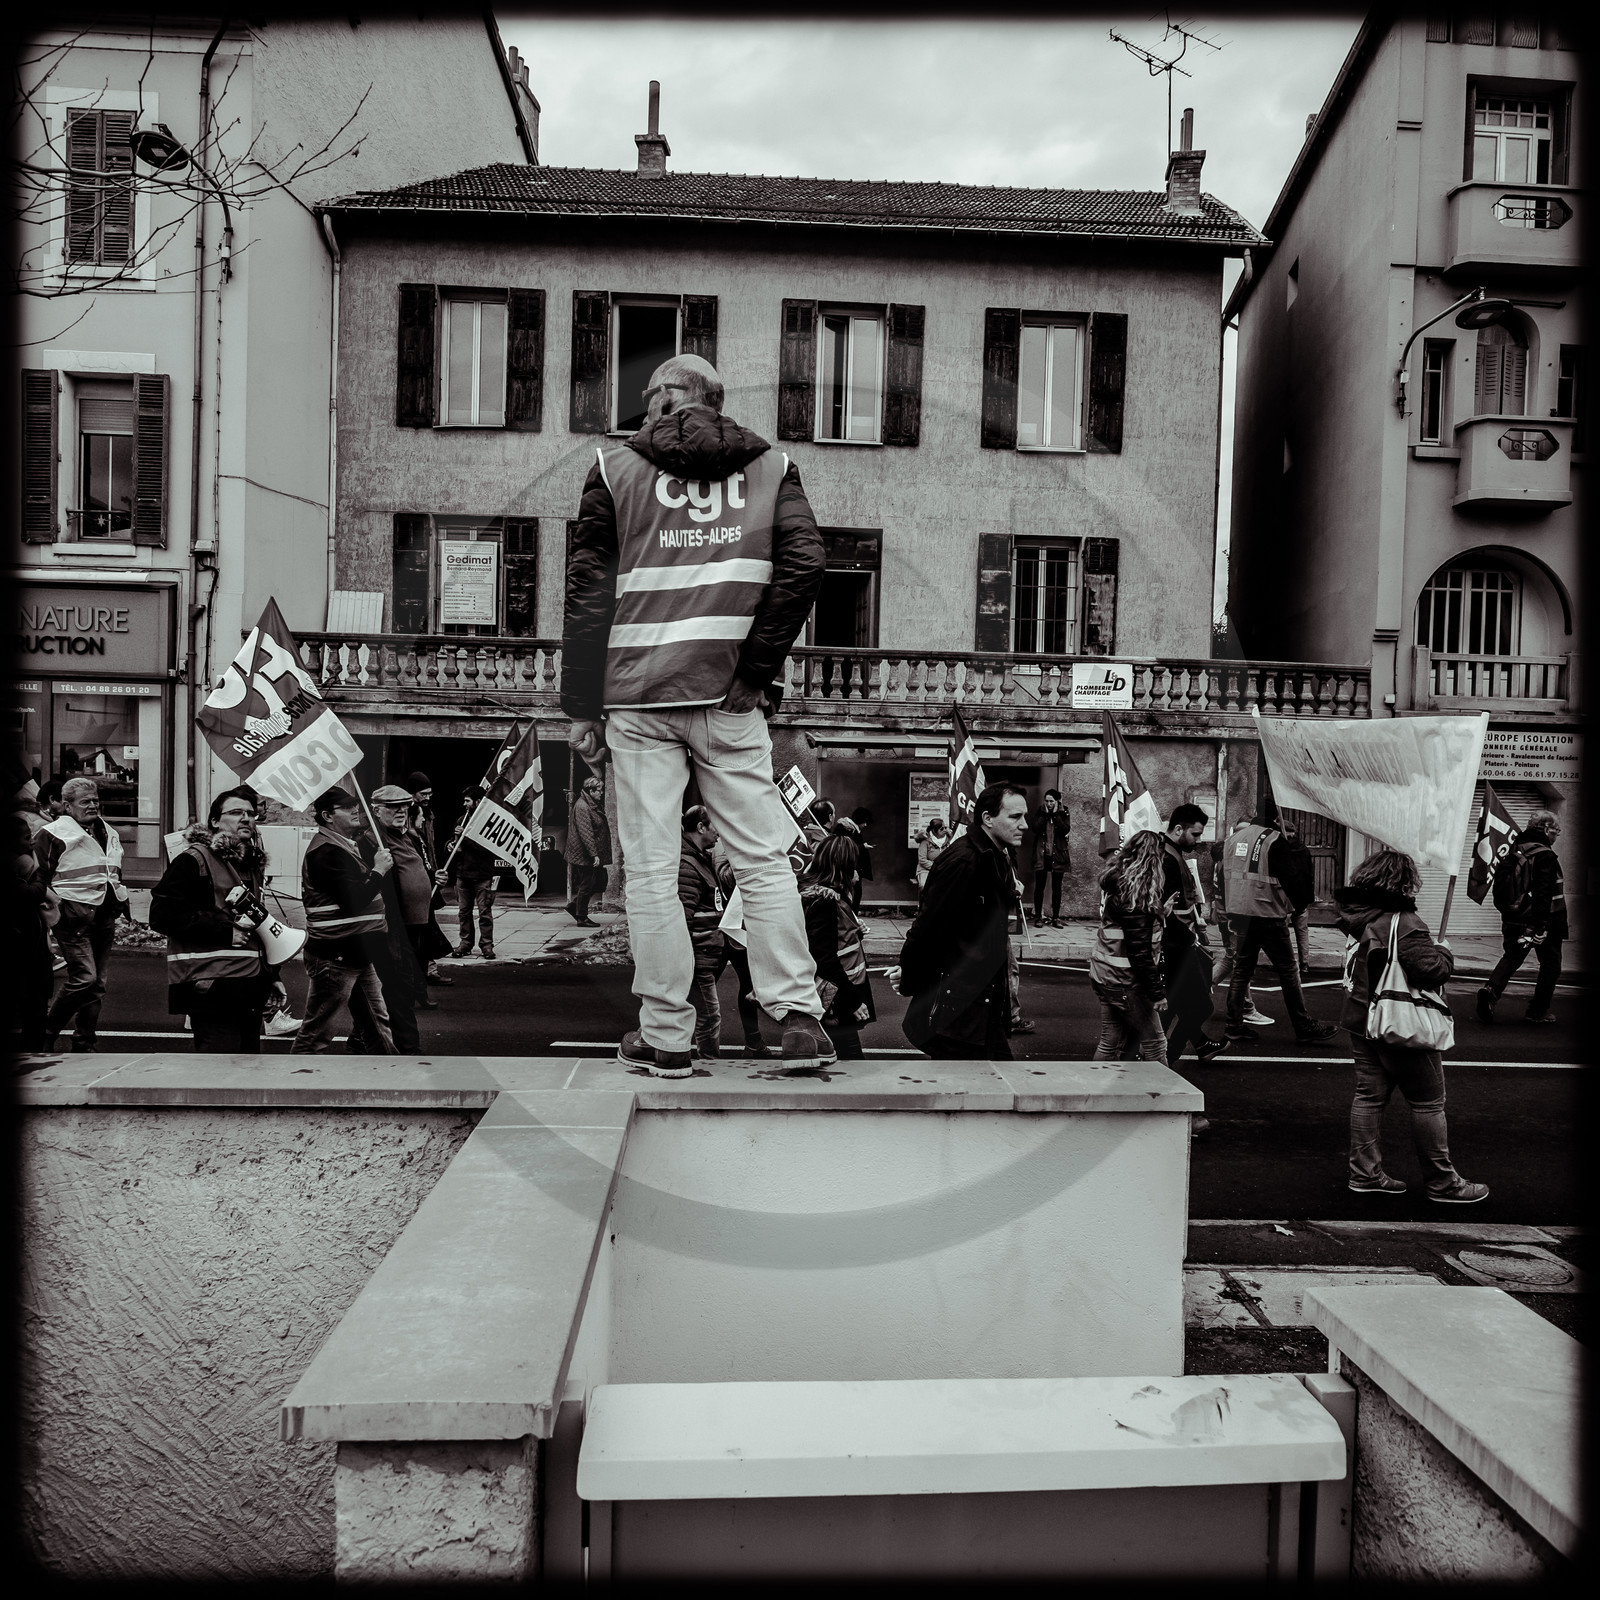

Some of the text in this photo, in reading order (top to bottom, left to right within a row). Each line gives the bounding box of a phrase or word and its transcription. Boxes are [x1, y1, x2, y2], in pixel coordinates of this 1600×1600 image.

[655, 469, 746, 523] cgt
[659, 525, 742, 548] HAUTES-ALPES
[446, 555, 492, 565] Gedimat
[16, 604, 129, 633] NATURE
[8, 635, 105, 656] RUCTION
[60, 684, 78, 692] TÉL.
[112, 685, 123, 693] 26
[138, 686, 150, 694] 20
[1523, 734, 1574, 744] ISOLATION
[1519, 744, 1558, 752] GÉNÉRALE
[1510, 752, 1546, 760] Ravalement
[1556, 753, 1579, 762] façades
